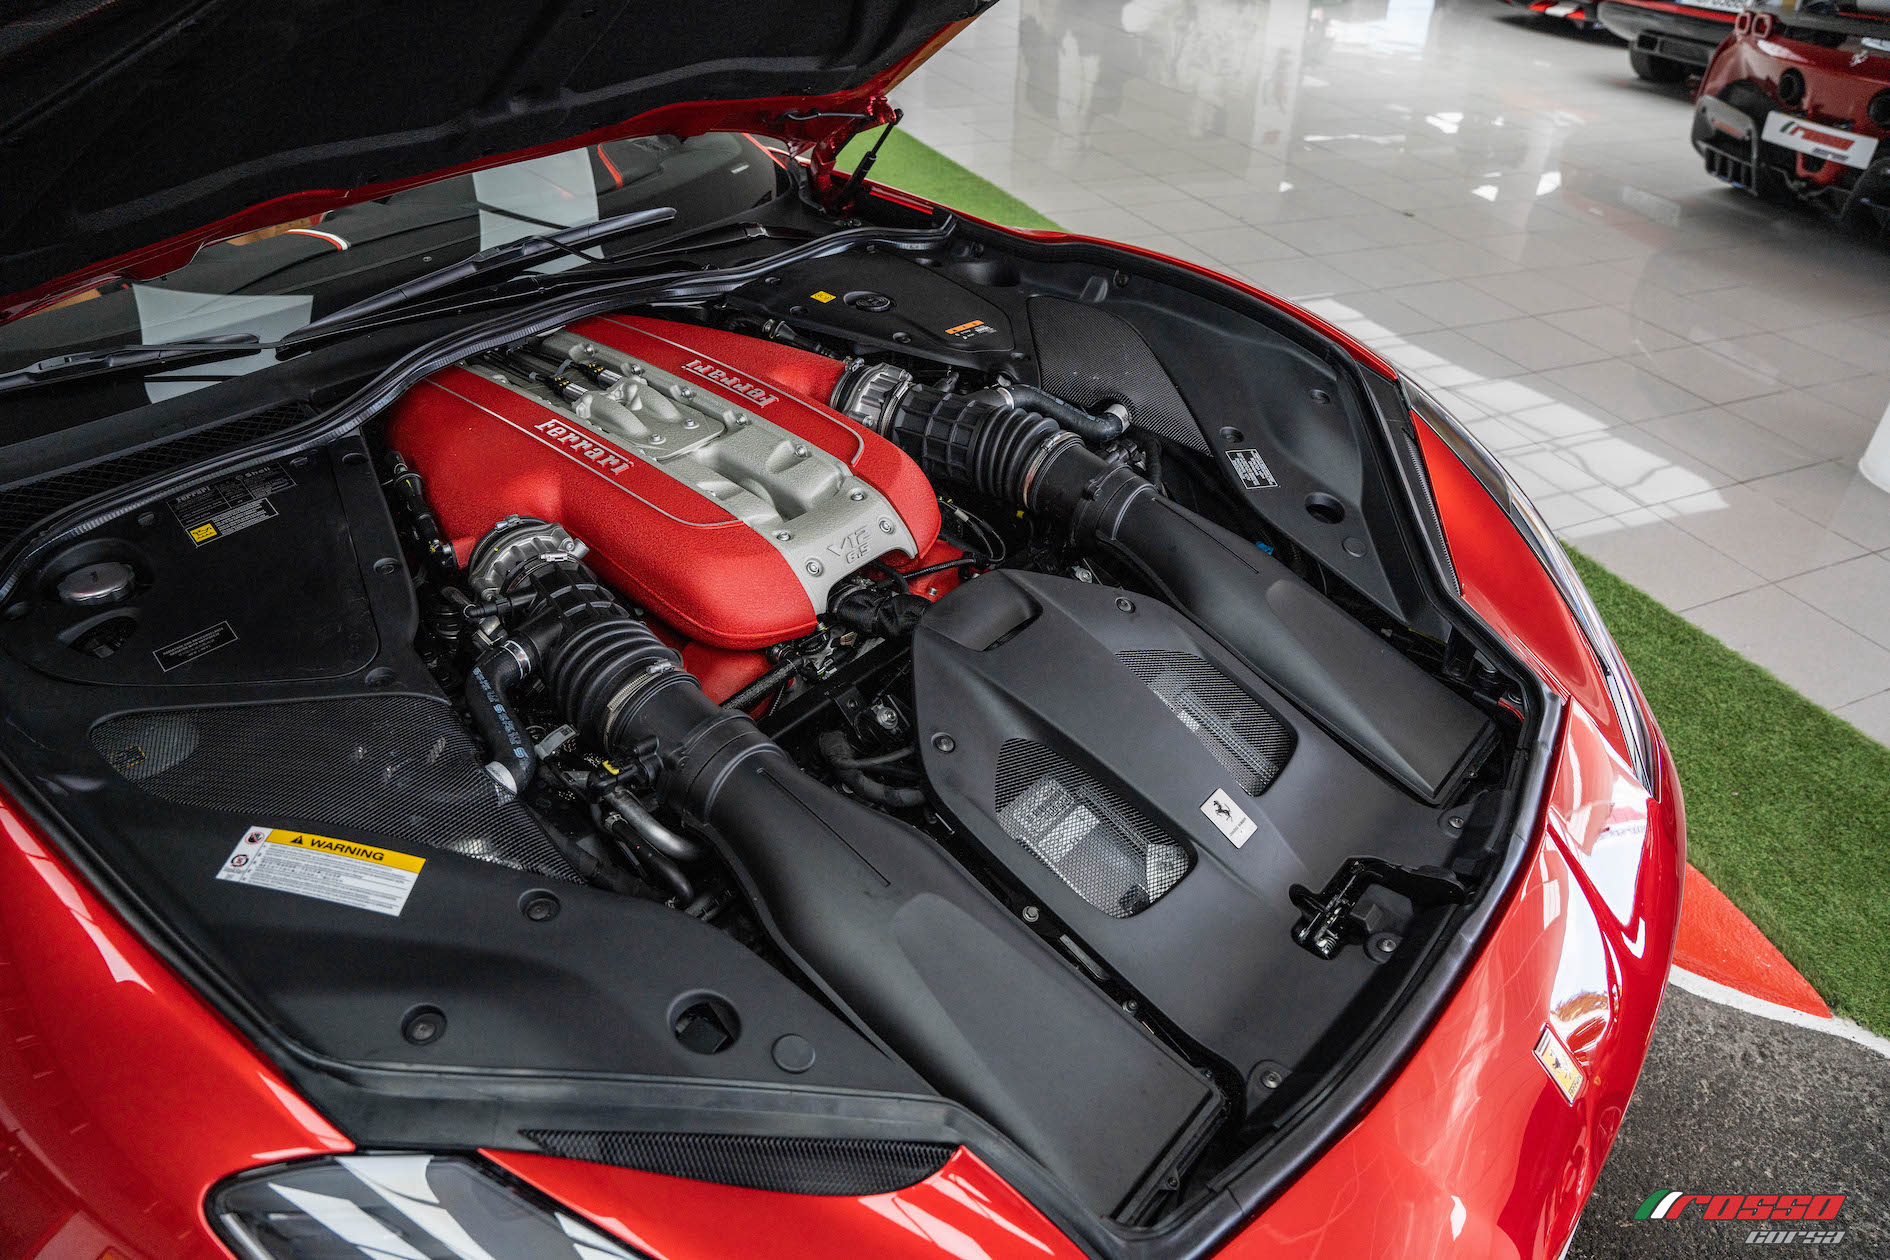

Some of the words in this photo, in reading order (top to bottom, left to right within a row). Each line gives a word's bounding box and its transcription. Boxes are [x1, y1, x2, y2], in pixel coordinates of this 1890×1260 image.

[681, 359, 779, 408] Ferrari
[534, 419, 634, 475] Ferrari
[245, 467, 271, 478] Shell
[827, 525, 872, 556] V12
[310, 838, 385, 862] WARNING
